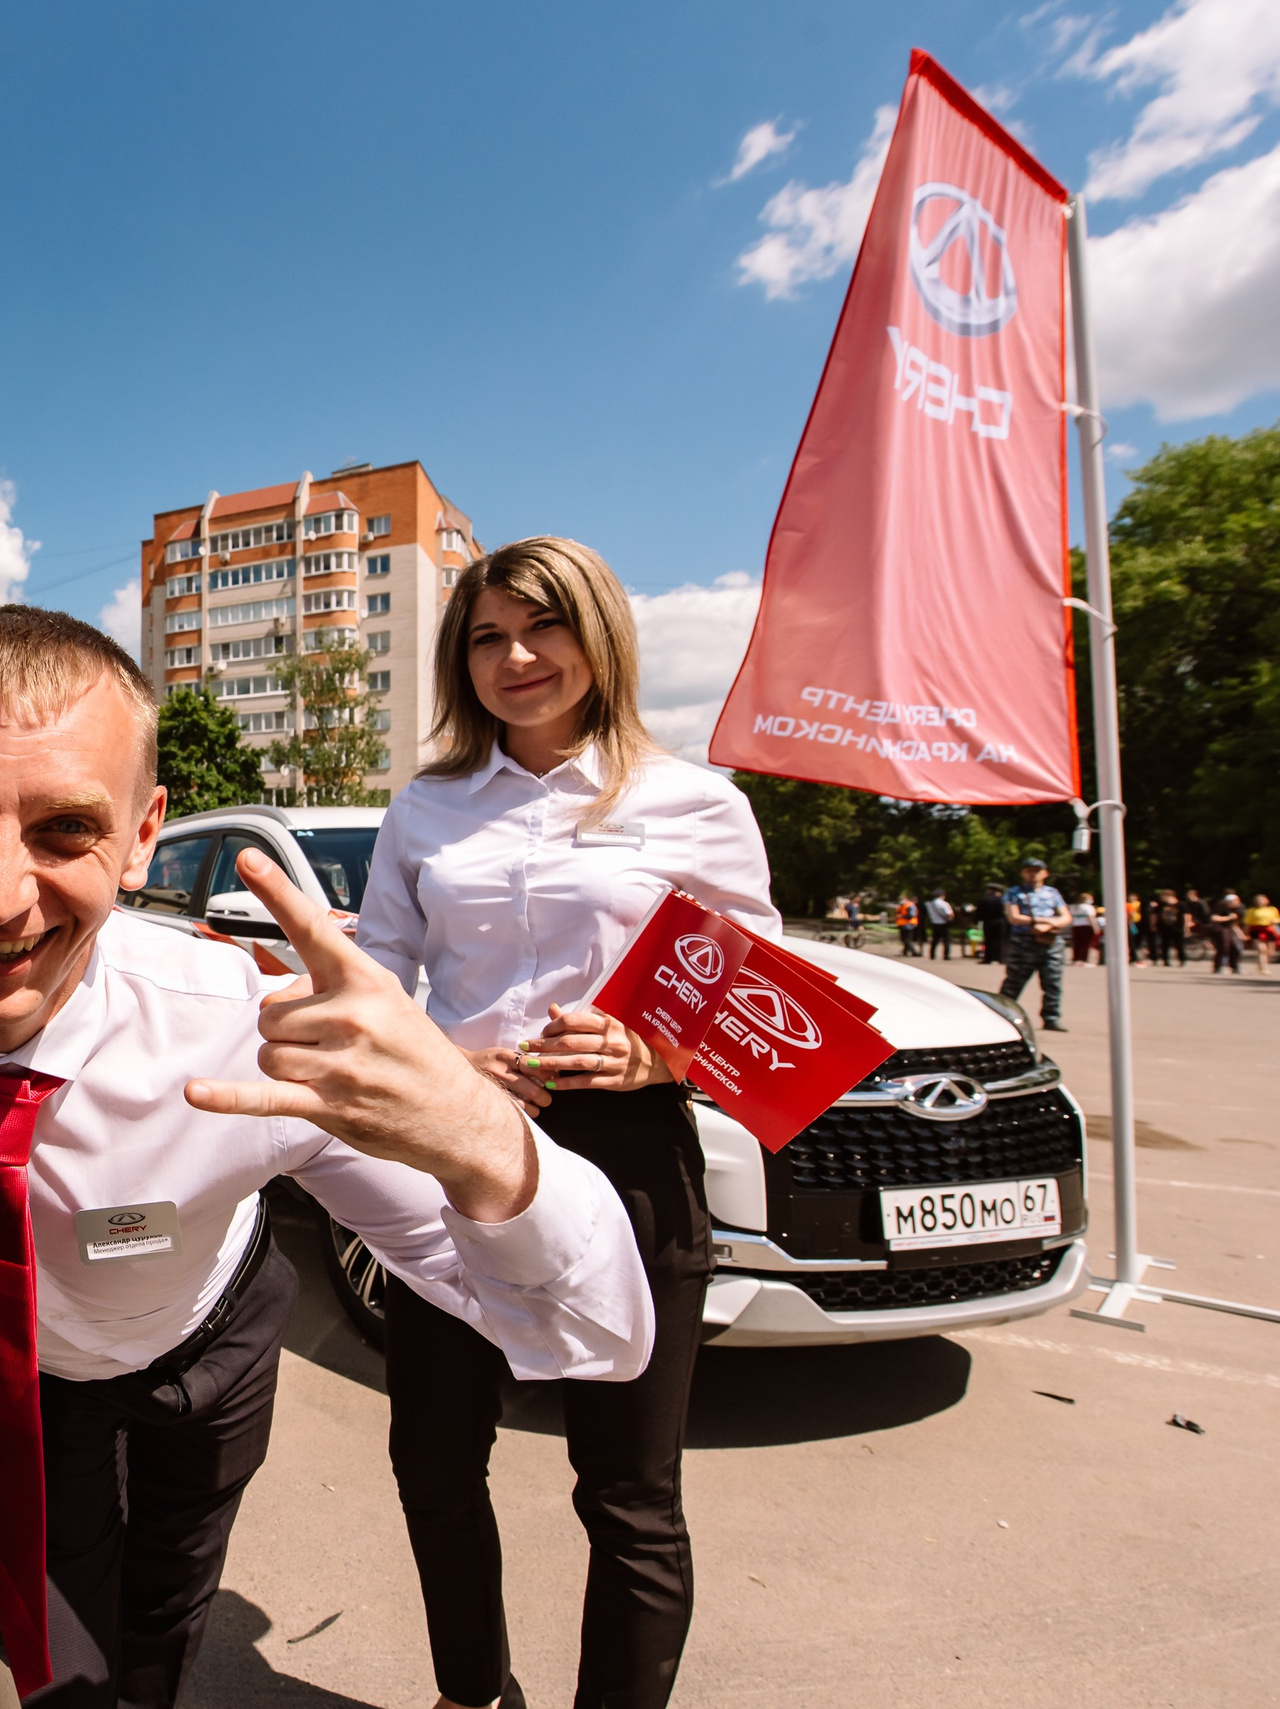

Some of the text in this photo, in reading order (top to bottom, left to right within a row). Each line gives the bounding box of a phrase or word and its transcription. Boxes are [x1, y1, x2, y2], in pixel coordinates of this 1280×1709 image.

[654, 965, 708, 1014] CHERY
[641, 1010, 652, 1023] НА
[693, 1051, 743, 1096] СНИНСКОМ
[709, 1050, 741, 1078] ЦЕНТР
[895, 1184, 1048, 1235] М850МО 67
[109, 1225, 147, 1235] CHERY
